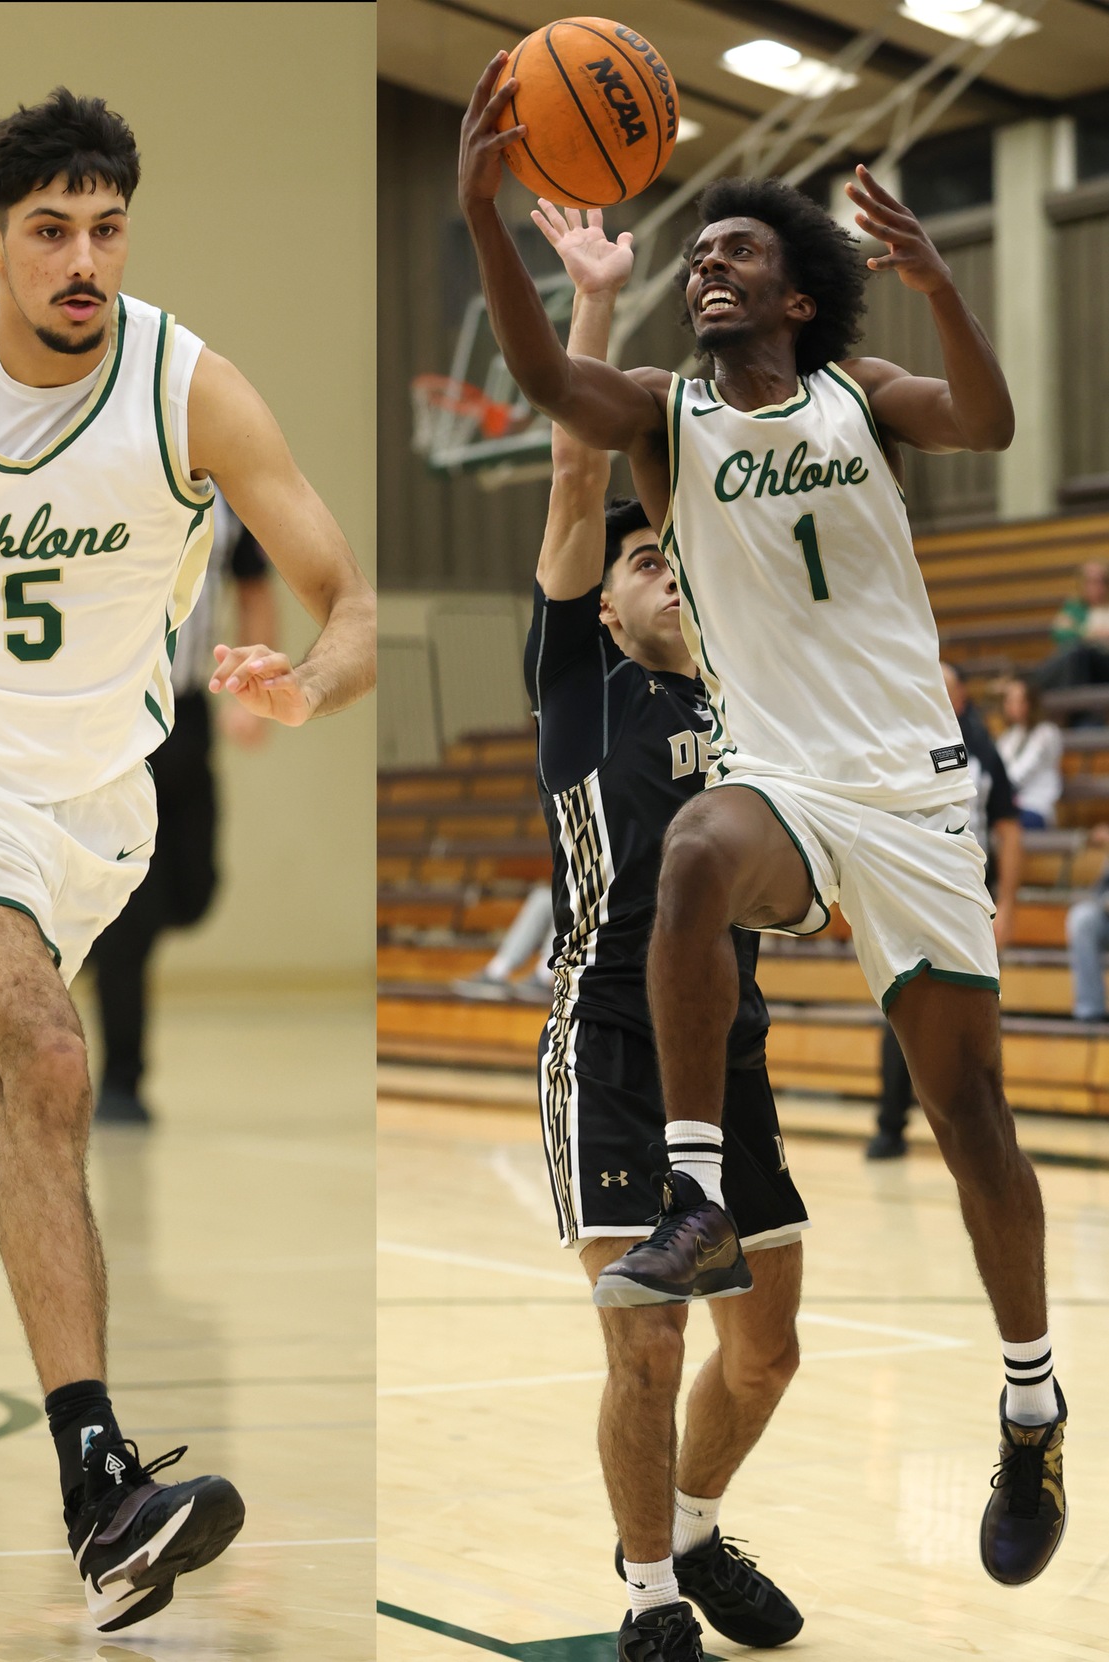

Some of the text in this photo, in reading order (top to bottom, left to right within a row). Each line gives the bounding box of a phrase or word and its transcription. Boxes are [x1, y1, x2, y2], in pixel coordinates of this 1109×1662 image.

[585, 56, 649, 147] NCAA
[614, 25, 677, 143] Wilson
[713, 440, 869, 503] Ohlone
[791, 511, 832, 603] 1
[2, 566, 65, 664] 5
